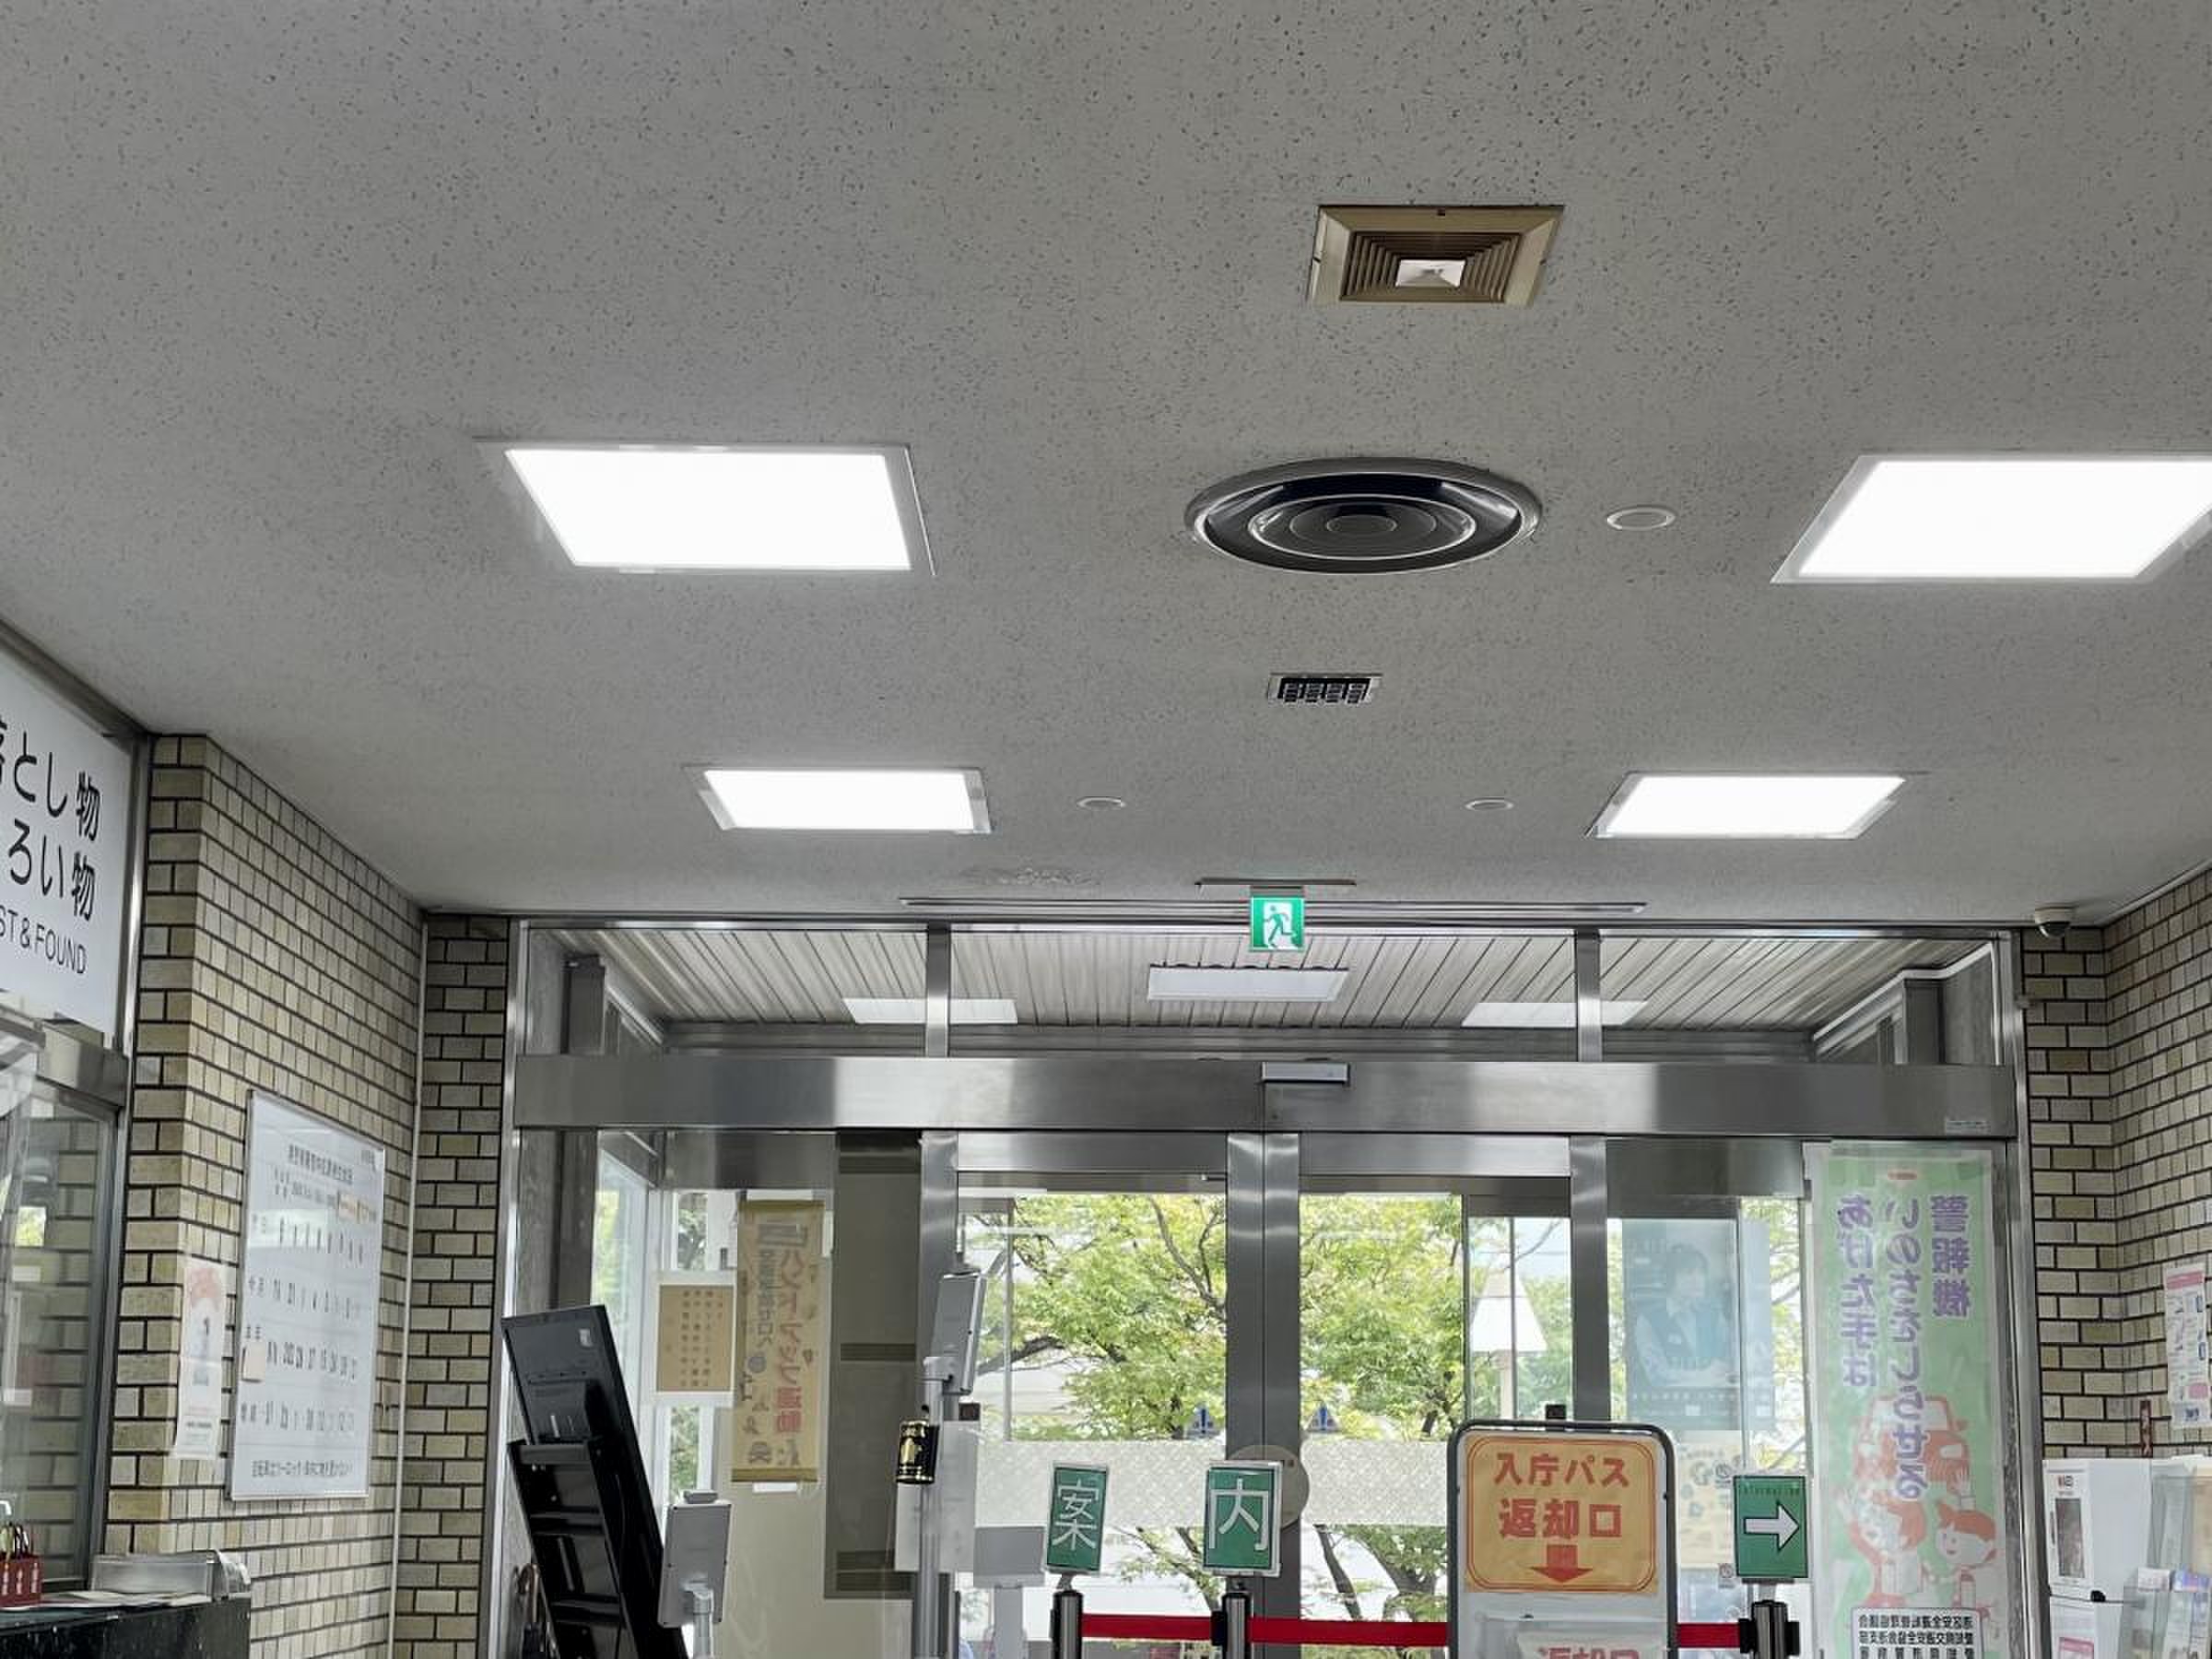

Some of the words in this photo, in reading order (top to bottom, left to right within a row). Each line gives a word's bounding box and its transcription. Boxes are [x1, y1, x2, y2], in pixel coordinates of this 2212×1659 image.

[0, 715, 100, 841] とし物
[20, 916, 30, 949] &
[34, 923, 88, 974] FOUND
[1494, 1452, 1630, 1488] 入庁パス
[1052, 1477, 1100, 1551] 案
[1209, 1477, 1269, 1550] 内
[1499, 1498, 1623, 1540] 返却口
